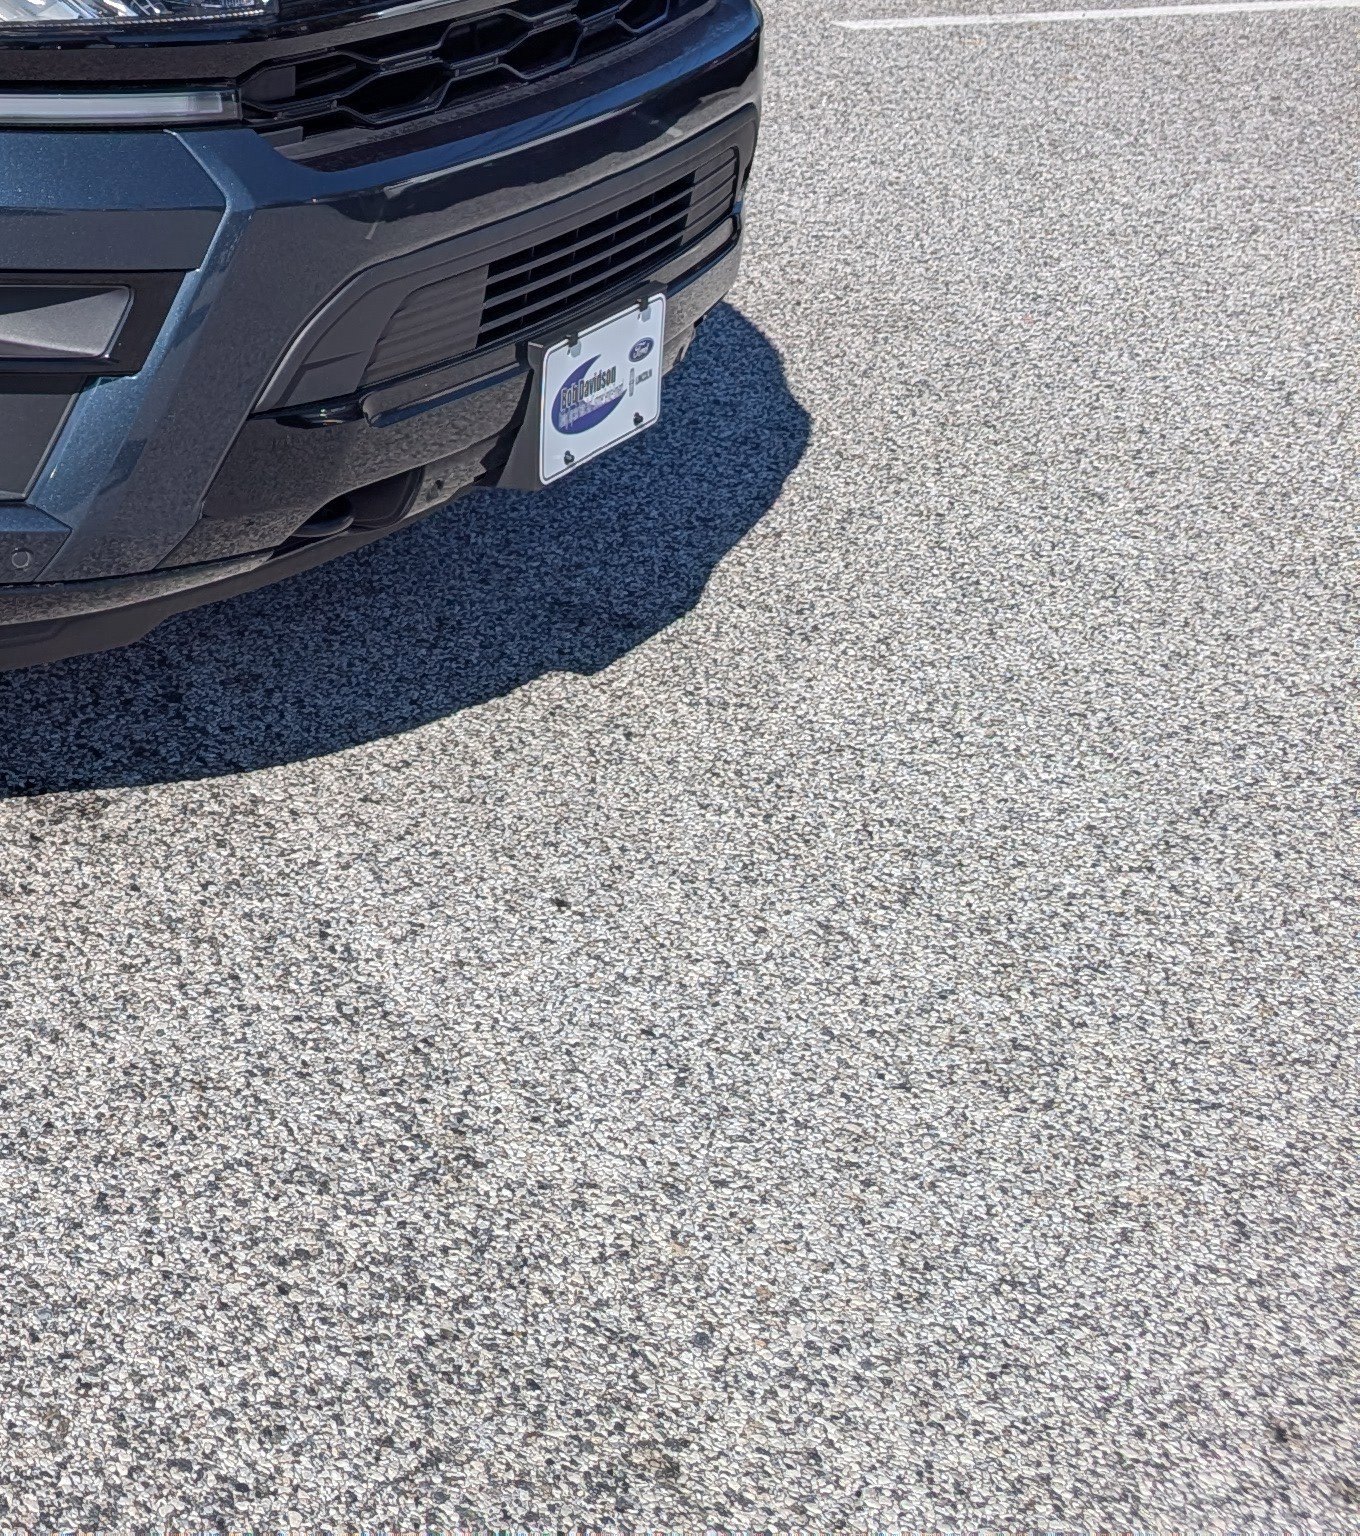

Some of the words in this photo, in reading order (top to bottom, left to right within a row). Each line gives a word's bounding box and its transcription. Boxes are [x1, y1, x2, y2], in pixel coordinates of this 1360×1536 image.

[630, 339, 651, 359] Ford
[560, 383, 579, 412] Bob
[579, 365, 617, 402] Davidson
